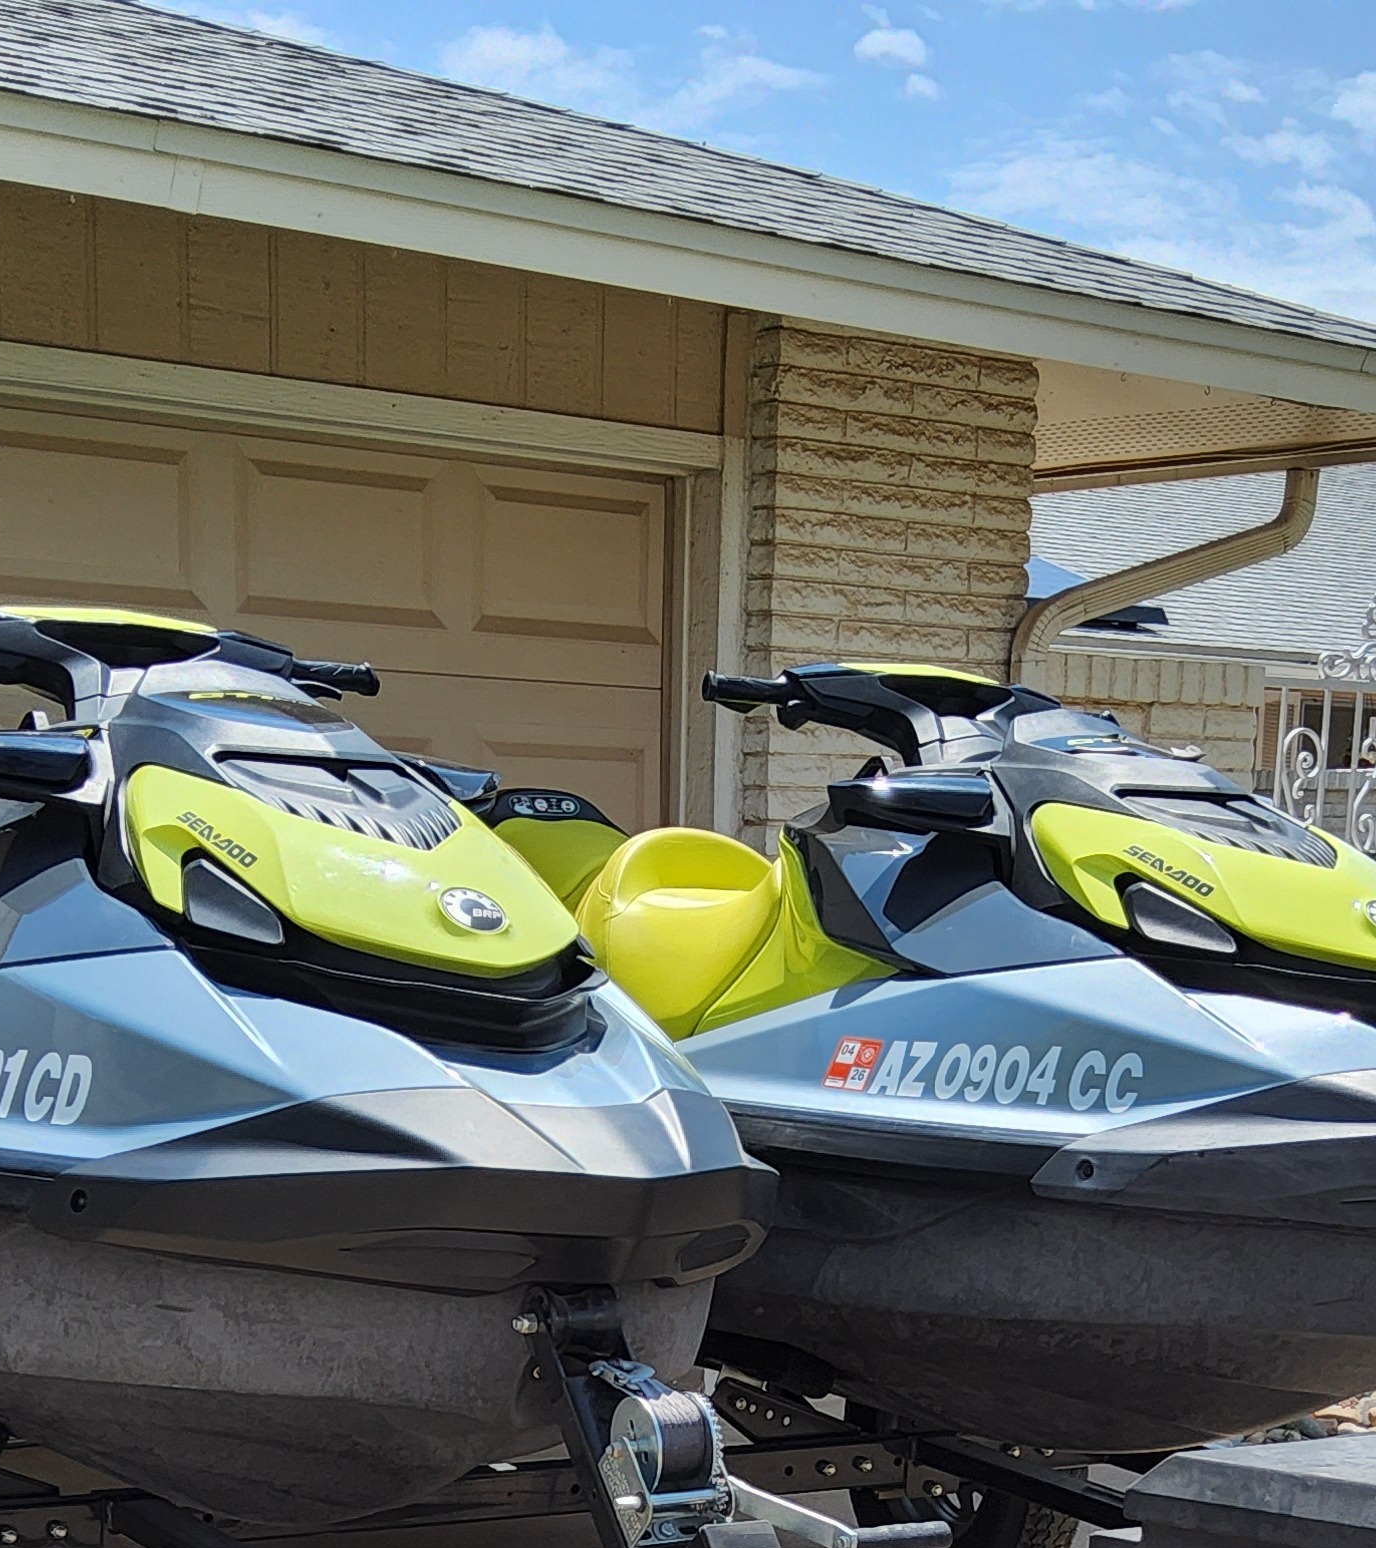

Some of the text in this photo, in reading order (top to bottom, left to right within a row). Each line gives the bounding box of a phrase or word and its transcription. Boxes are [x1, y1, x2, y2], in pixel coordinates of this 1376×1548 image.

[472, 907, 502, 919] BRP
[841, 1044, 856, 1056] 04
[850, 1069, 866, 1082] 26
[866, 1040, 1144, 1114] AZ 0904 CC
[23, 1052, 93, 1126] CD
